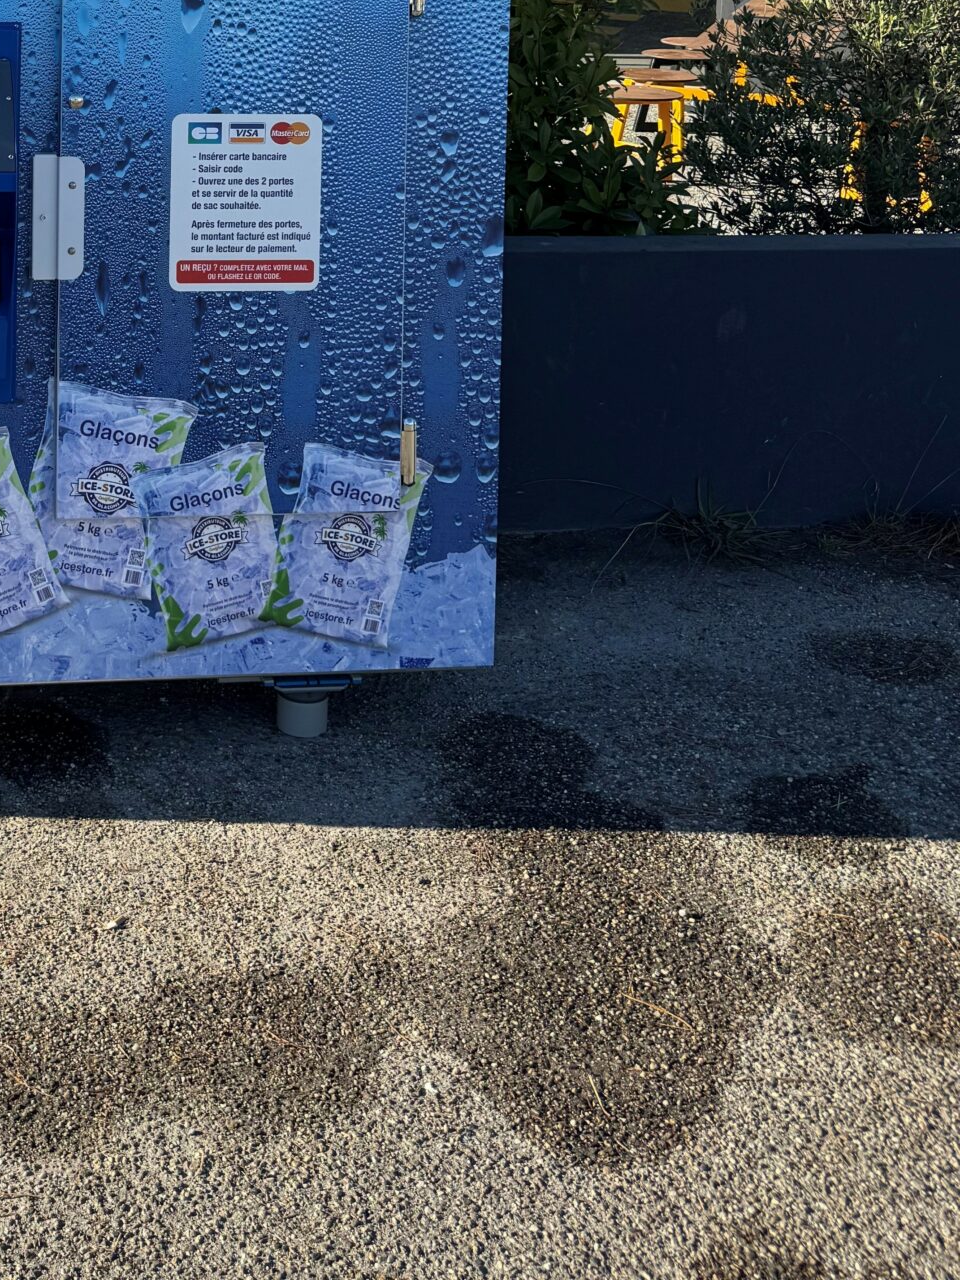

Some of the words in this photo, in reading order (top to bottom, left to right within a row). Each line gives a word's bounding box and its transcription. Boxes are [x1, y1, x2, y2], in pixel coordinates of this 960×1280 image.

[236, 128, 259, 137] VISA
[271, 129, 310, 138] MasterCard
[198, 152, 227, 161] Insérer
[229, 153, 250, 161] carte
[252, 152, 287, 161] bancaire
[198, 164, 221, 173] Saisir
[223, 164, 243, 173] code
[198, 177, 226, 185] Ouvrez
[245, 177, 259, 185] des
[261, 177, 267, 185] 2
[268, 177, 294, 187] portes
[213, 189, 237, 197] servir
[239, 189, 248, 197] de
[250, 189, 258, 197] la
[260, 189, 294, 199] quantité
[192, 201, 202, 210] de
[204, 202, 218, 210] sac
[220, 201, 262, 210] souhaitée.
[191, 220, 215, 230] Après
[217, 220, 256, 228] fermeture
[258, 220, 273, 228] des
[275, 220, 303, 230] portes,
[191, 232, 199, 240] le
[236, 232, 265, 241] facturé
[281, 232, 311, 242] indiqué
[191, 245, 204, 253] sur
[206, 244, 214, 253] le
[216, 244, 243, 253] lecteur
[245, 244, 256, 253] de
[257, 244, 297, 254] paiement.
[192, 264, 212, 273] REÇU
[80, 419, 159, 449] Glaçons
[170, 483, 244, 512] Glaçons
[330, 480, 401, 509] Glaçons
[77, 521, 85, 532] 5
[88, 522, 101, 537] kg
[189, 530, 240, 551] ICE-STORE
[324, 530, 375, 549] ICE-STORE
[207, 579, 214, 590] 5
[216, 576, 229, 588] kg
[322, 572, 329, 583] 5
[332, 572, 344, 588] kg
